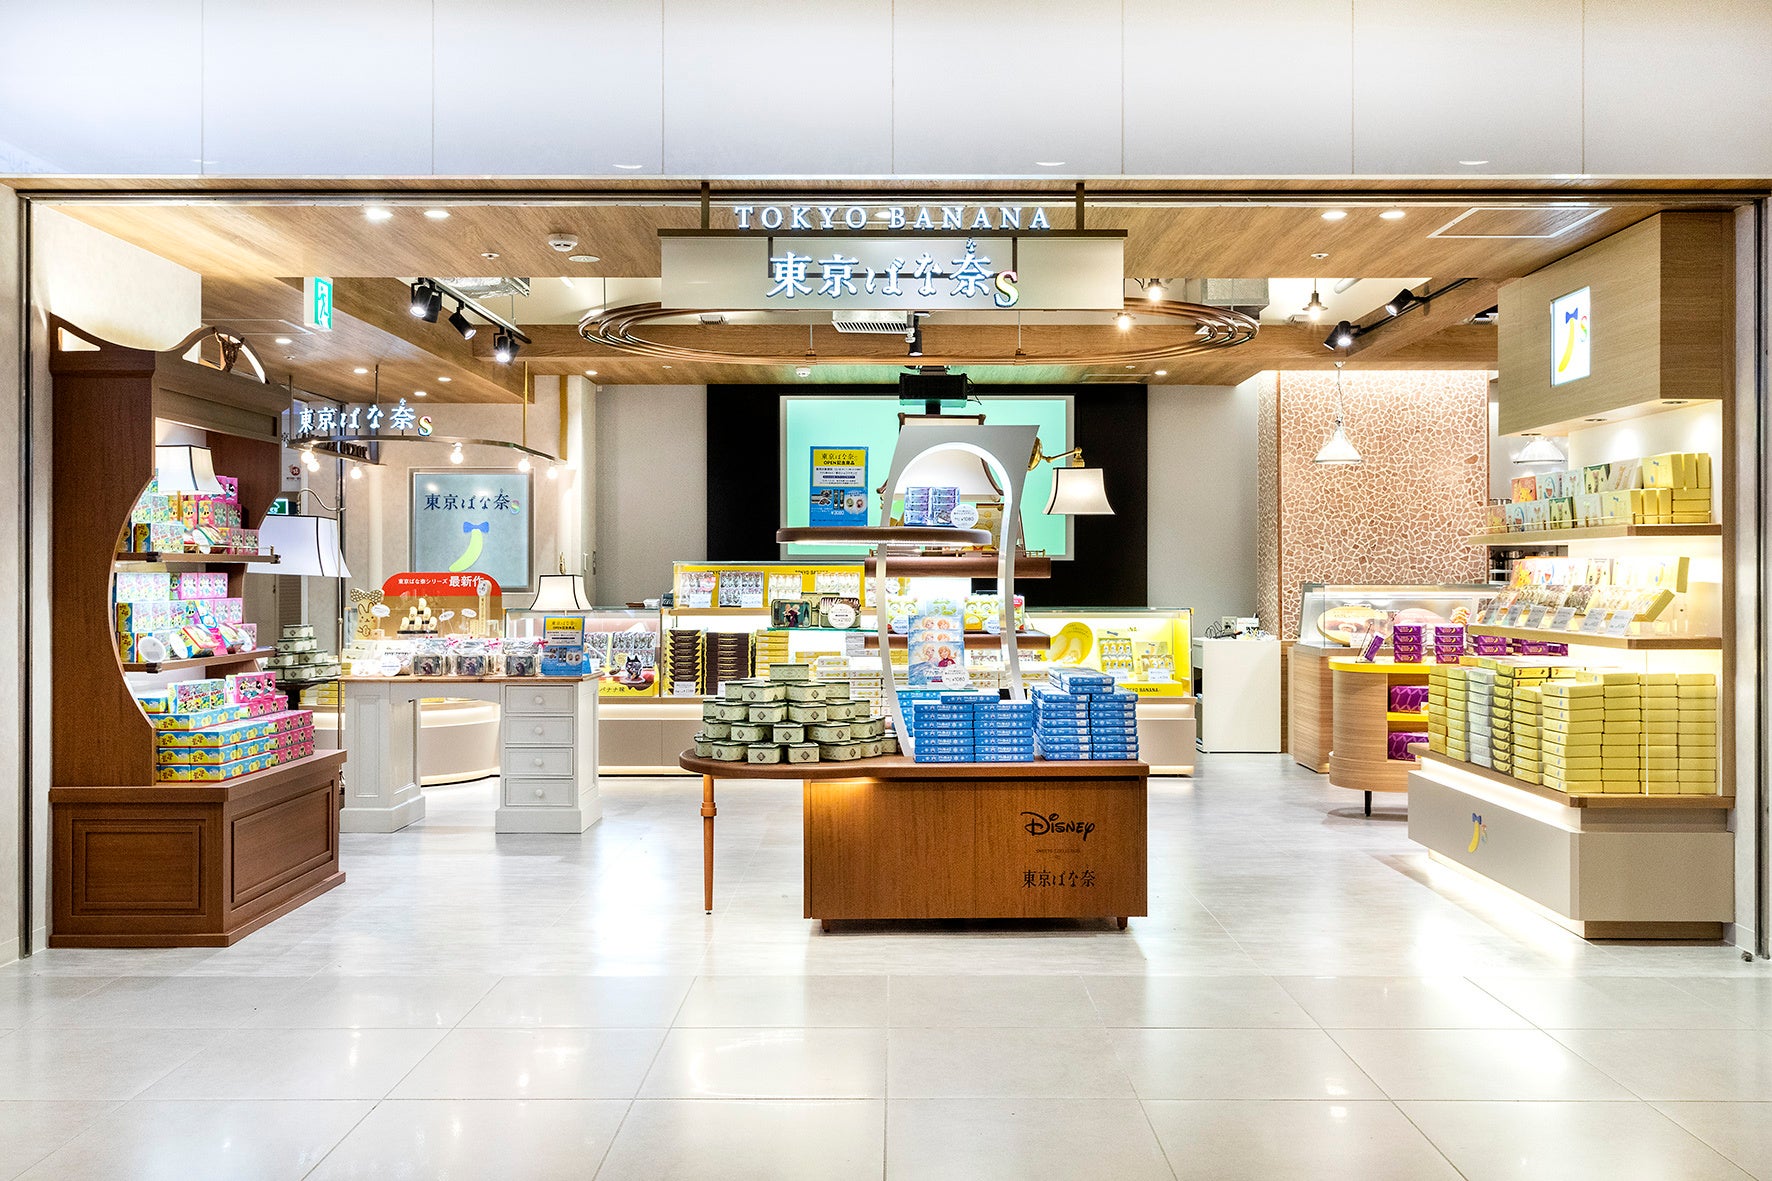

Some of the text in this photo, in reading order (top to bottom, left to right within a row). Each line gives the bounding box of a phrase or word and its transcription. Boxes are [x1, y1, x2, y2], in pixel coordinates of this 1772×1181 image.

[734, 205, 1051, 230] TOKYO BANANA
[1022, 866, 1096, 888] 東京ばな奈
